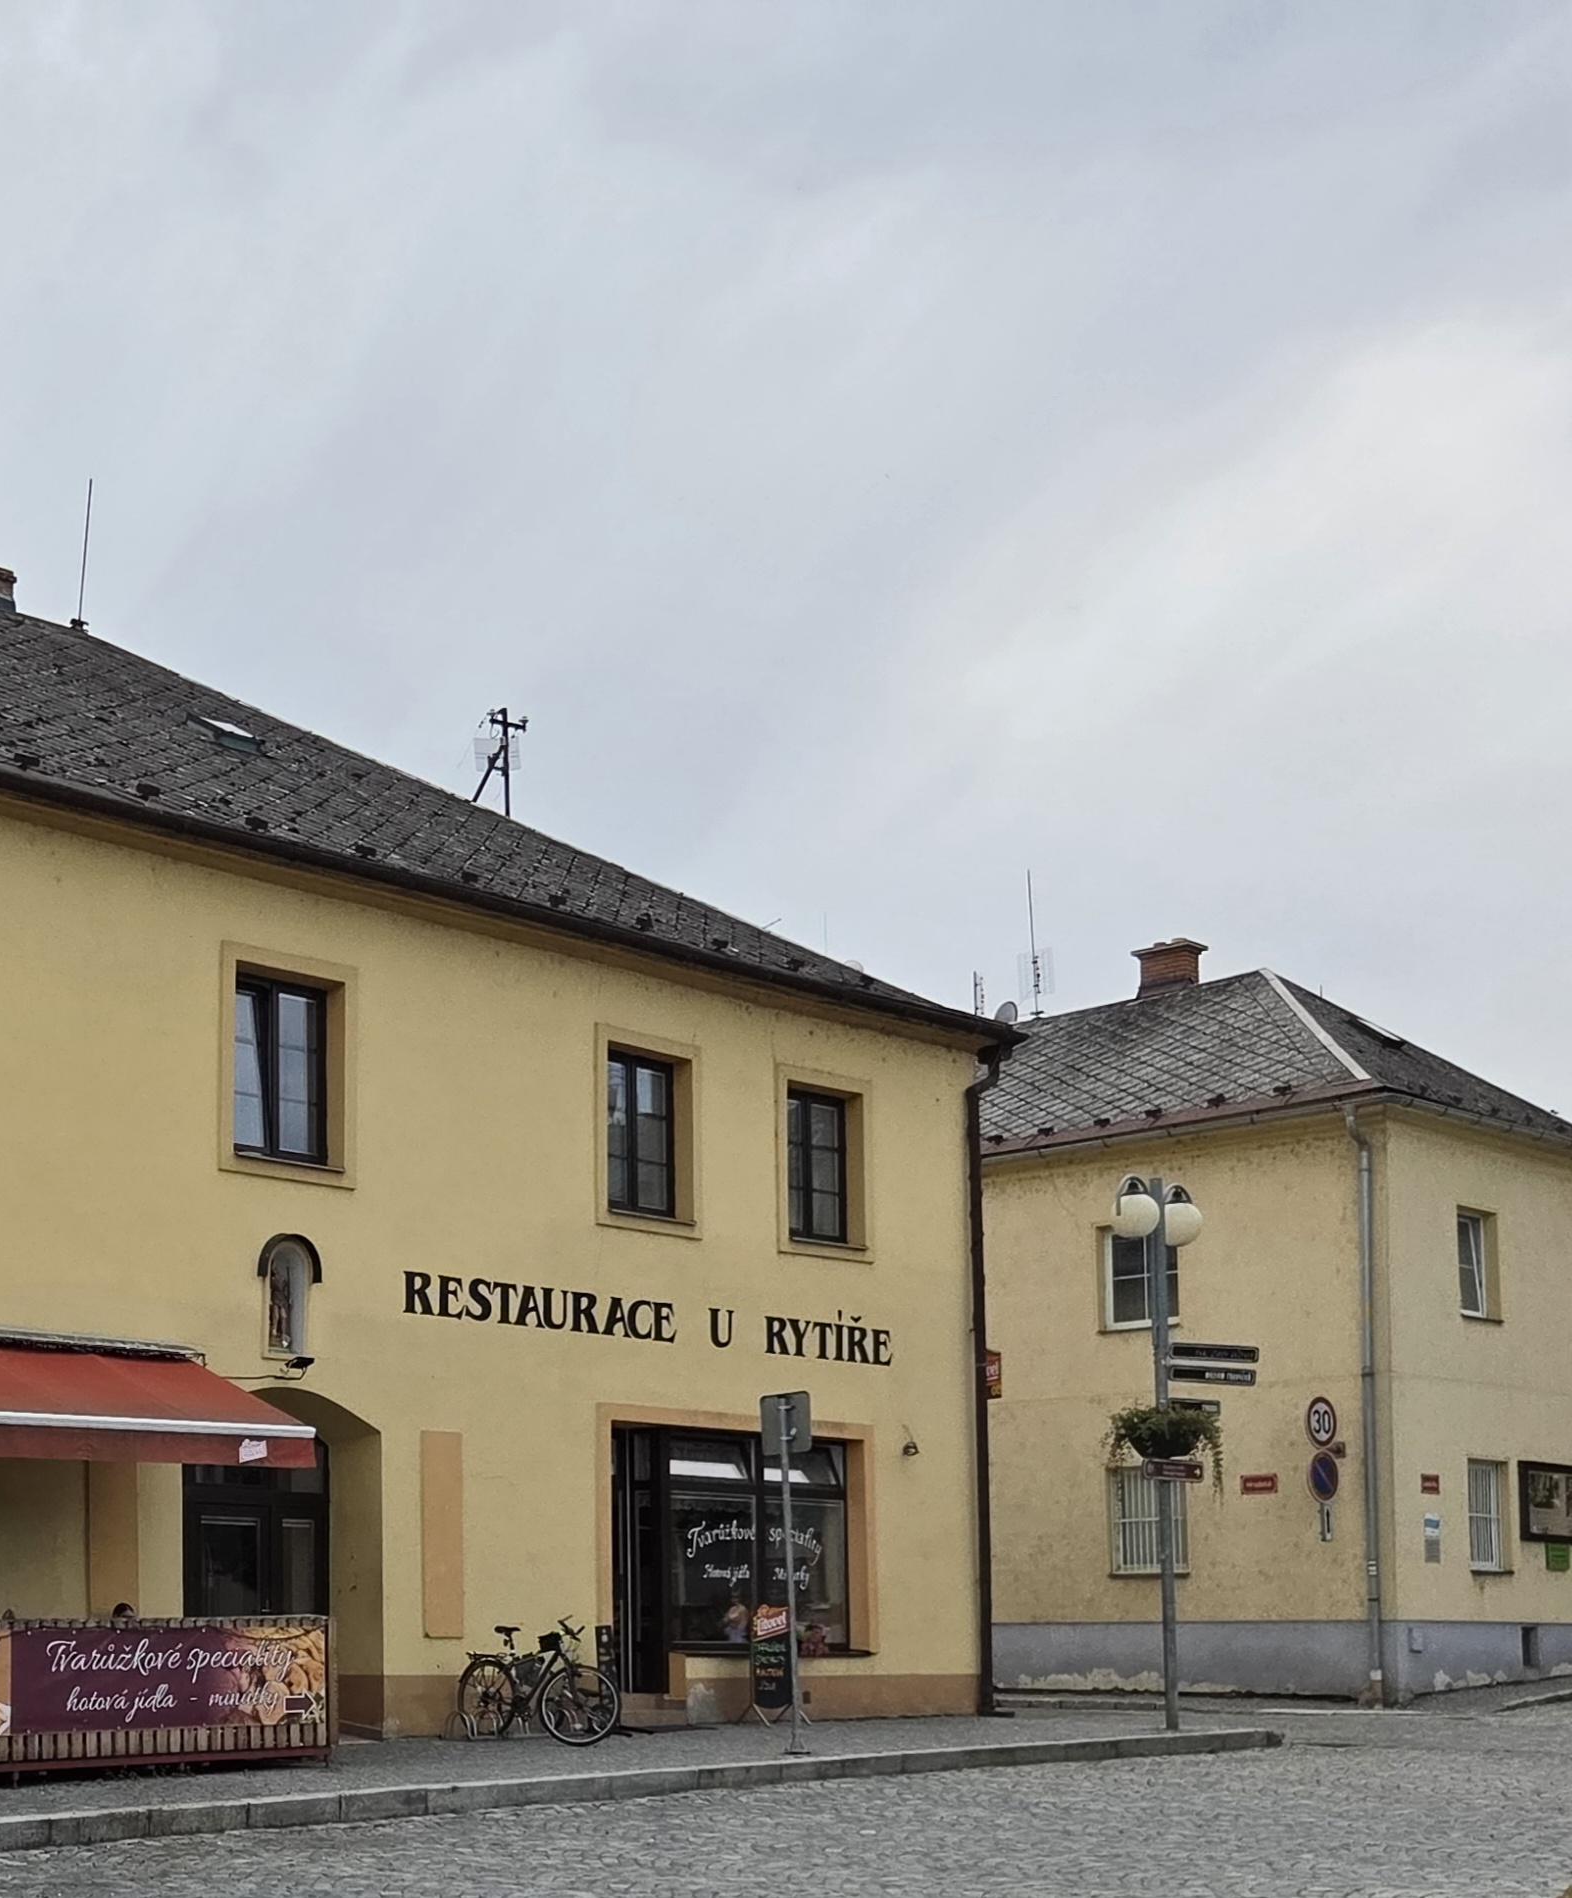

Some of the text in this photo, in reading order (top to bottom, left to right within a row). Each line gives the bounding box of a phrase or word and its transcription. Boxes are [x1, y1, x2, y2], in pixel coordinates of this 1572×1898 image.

[401, 1269, 893, 1367] RESTAURACE U RYTÍŘE
[1312, 1409, 1331, 1435] 30
[45, 1638, 294, 1683] Tvarůžkové speciality
[65, 1686, 130, 1712] hotová
[125, 1683, 178, 1723] jídla
